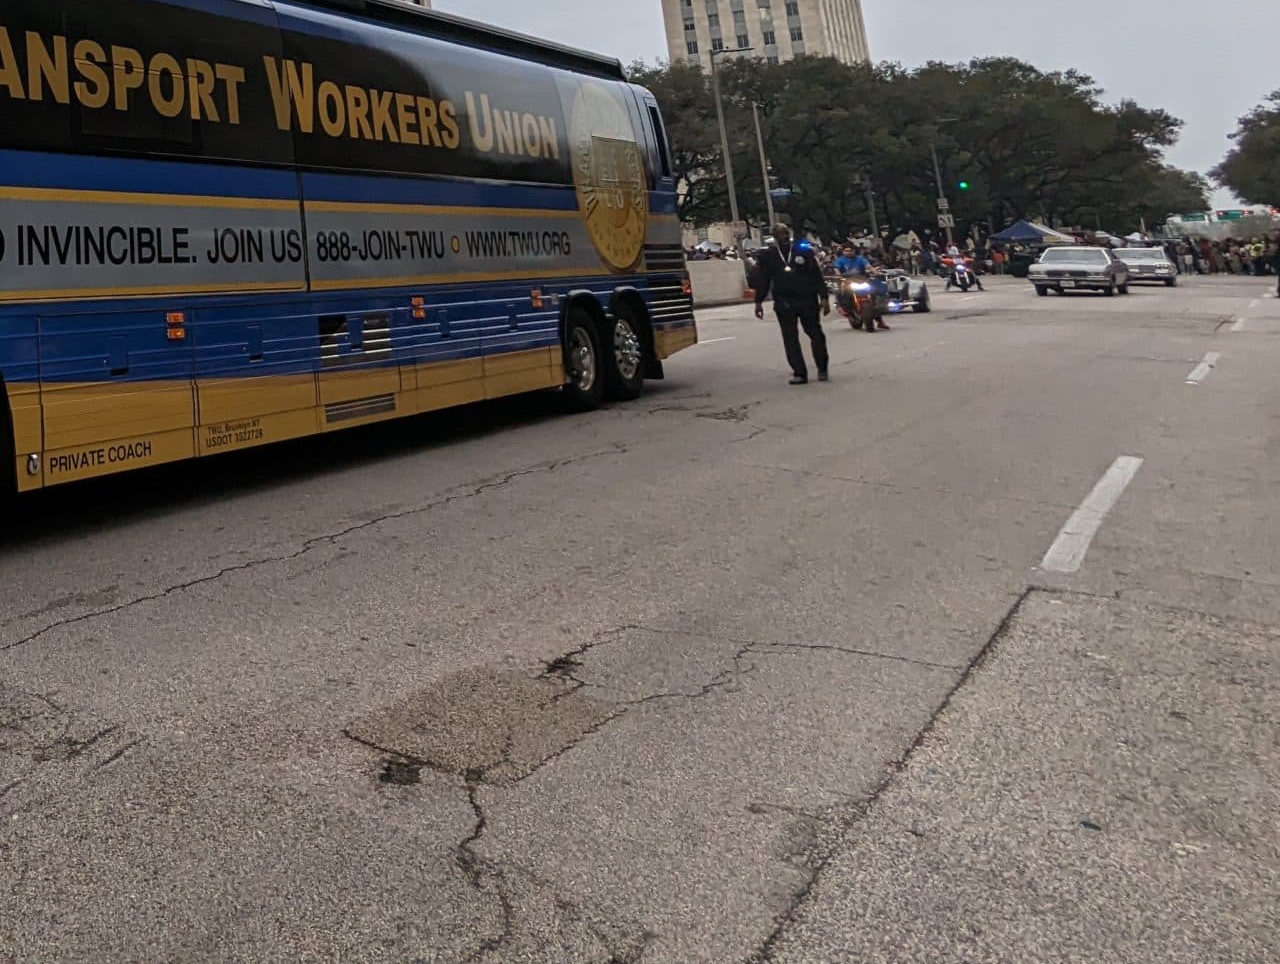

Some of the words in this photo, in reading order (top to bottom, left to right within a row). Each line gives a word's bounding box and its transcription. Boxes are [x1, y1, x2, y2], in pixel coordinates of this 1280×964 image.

[263, 55, 459, 150] WORKERS
[464, 90, 558, 160] UNION
[17, 225, 198, 266] INVINCIBLE.
[207, 228, 264, 264] JOIN
[270, 229, 302, 263] US
[317, 229, 445, 262] 888-JOIN-TWU
[465, 230, 572, 257] WWW.TWU.ORG
[50, 448, 106, 474] PRIVATE
[108, 441, 152, 463] COACH
[207, 433, 232, 448] USDOT
